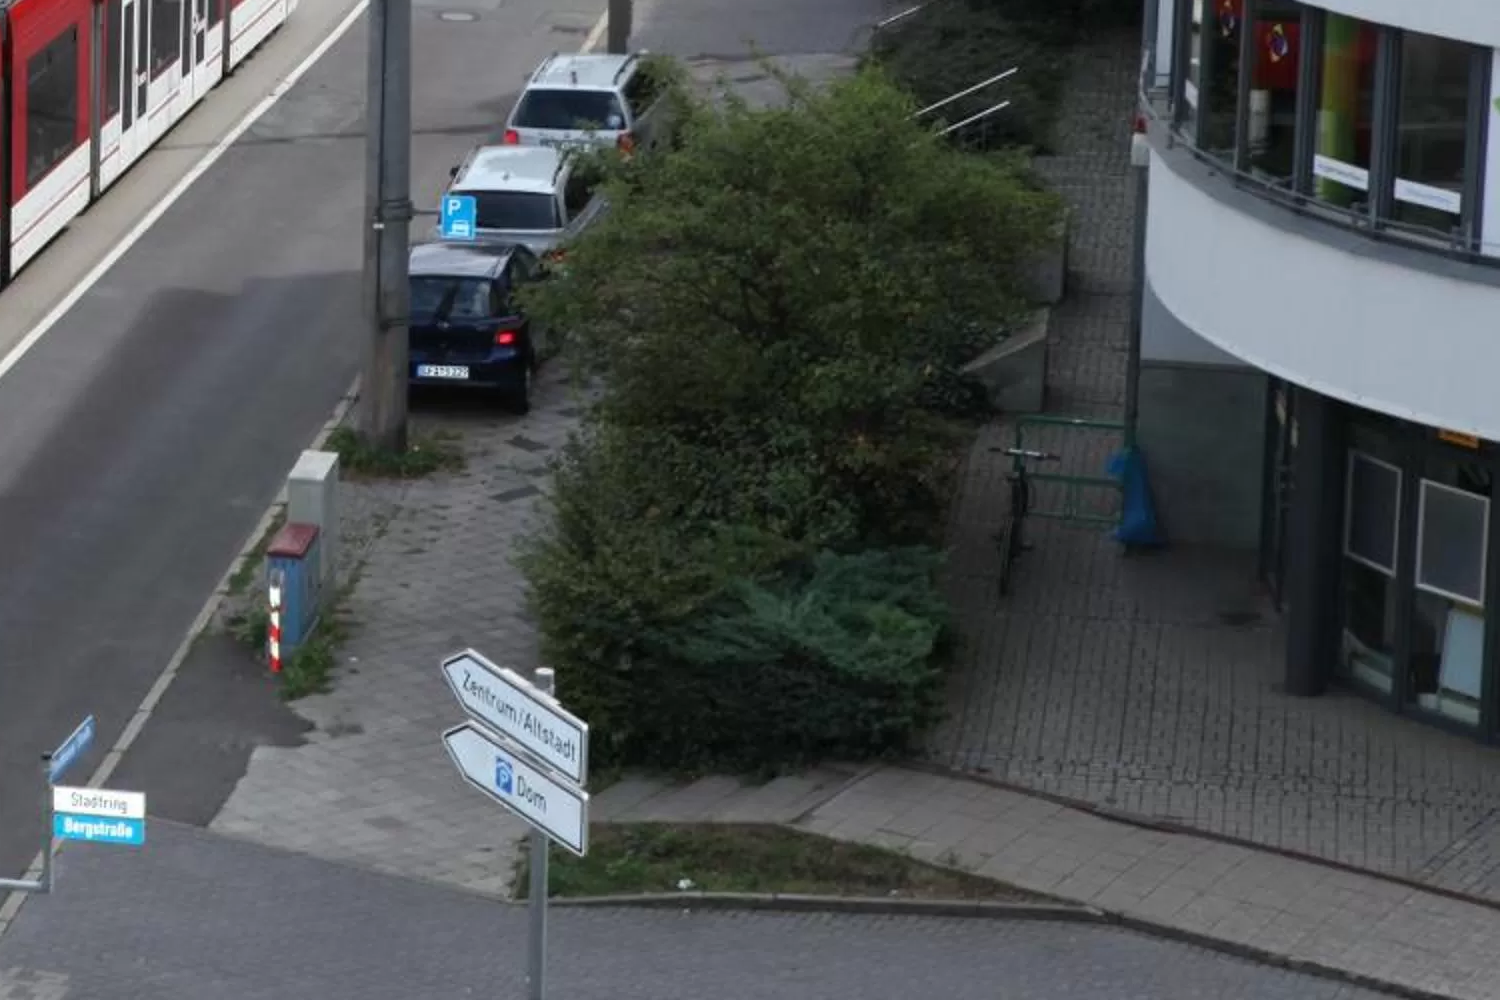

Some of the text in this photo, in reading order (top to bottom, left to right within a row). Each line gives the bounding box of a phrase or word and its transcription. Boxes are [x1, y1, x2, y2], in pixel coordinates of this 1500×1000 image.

[448, 199, 461, 216] P
[463, 669, 575, 762] Zentrum/Altstadt
[71, 791, 128, 814] Stadtring
[517, 775, 547, 815] Dom
[63, 817, 133, 839] Bergstraße
